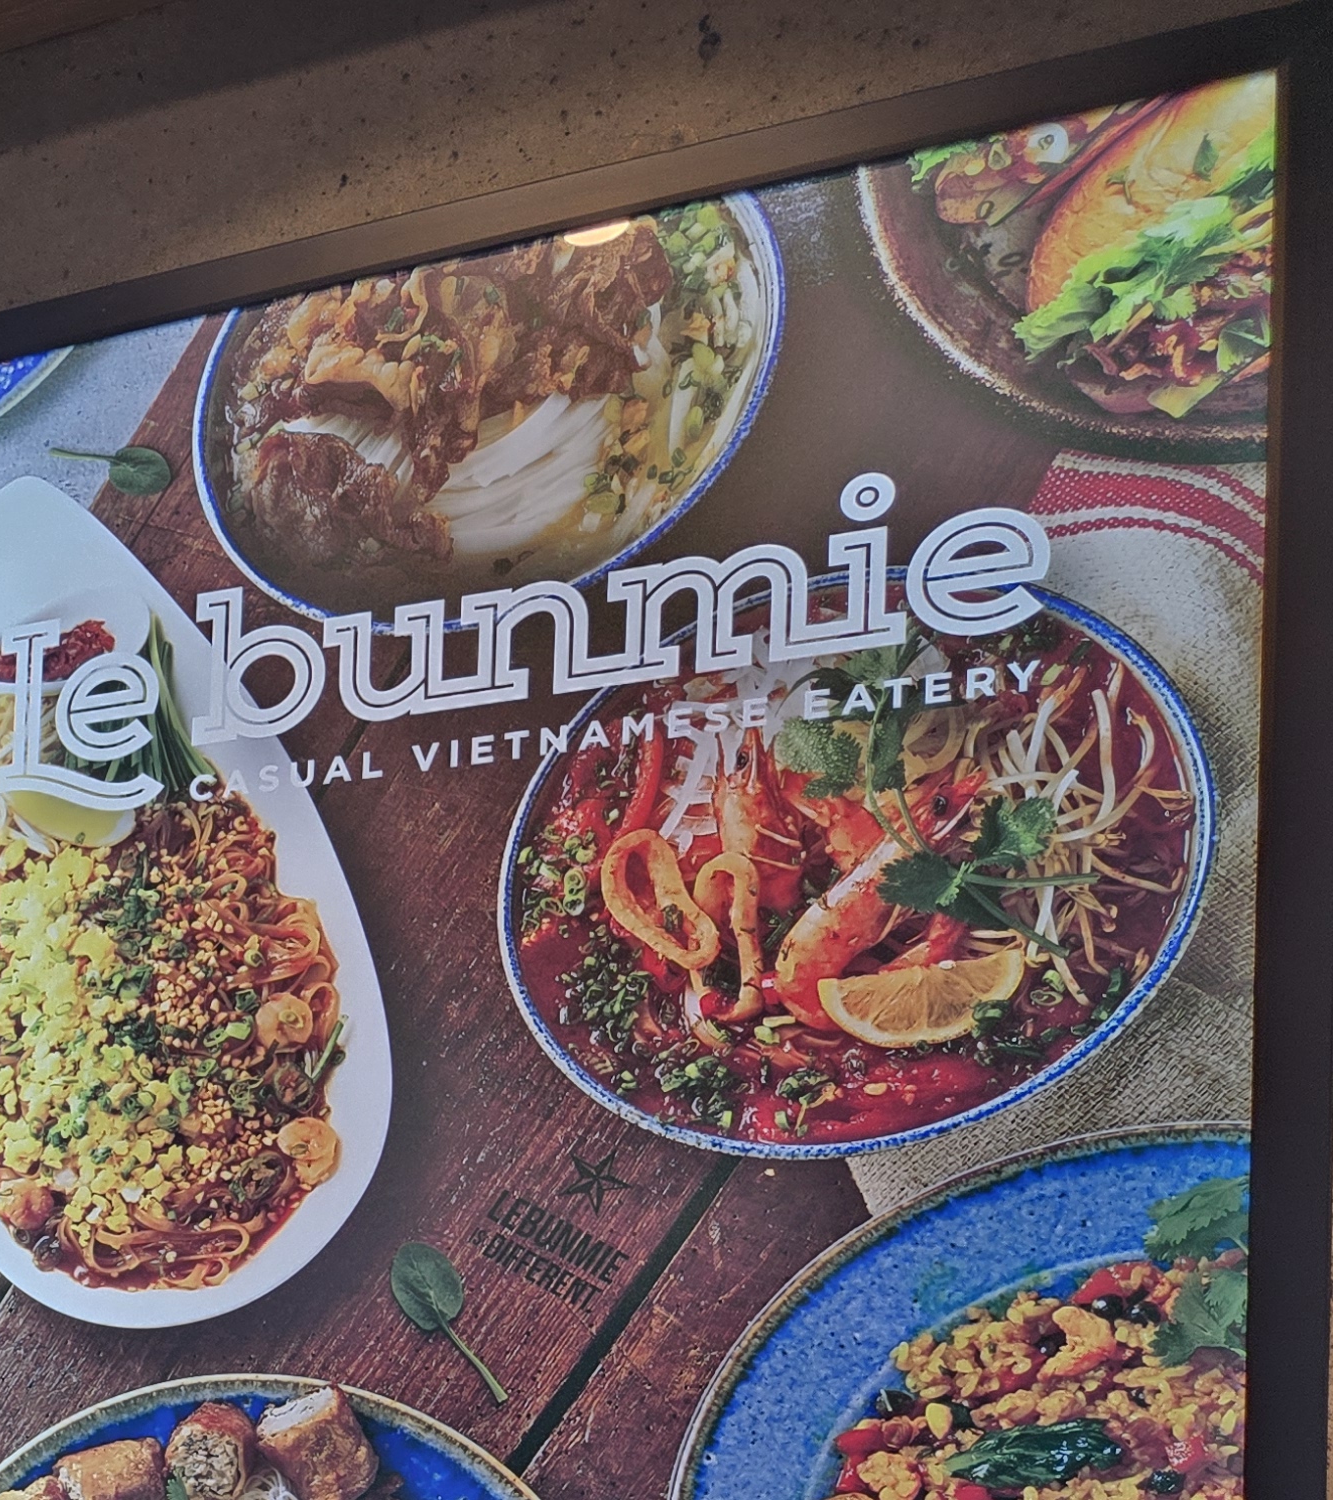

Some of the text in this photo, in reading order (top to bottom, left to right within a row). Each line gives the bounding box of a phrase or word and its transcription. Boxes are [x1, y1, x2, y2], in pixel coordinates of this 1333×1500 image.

[0, 471, 1050, 806] Le bunmie
[188, 657, 1043, 805] CASUAL VIETNAMESE EATERY
[483, 1233, 603, 1310] DIFFERENT
[487, 1190, 630, 1285] LEBUNMIE
